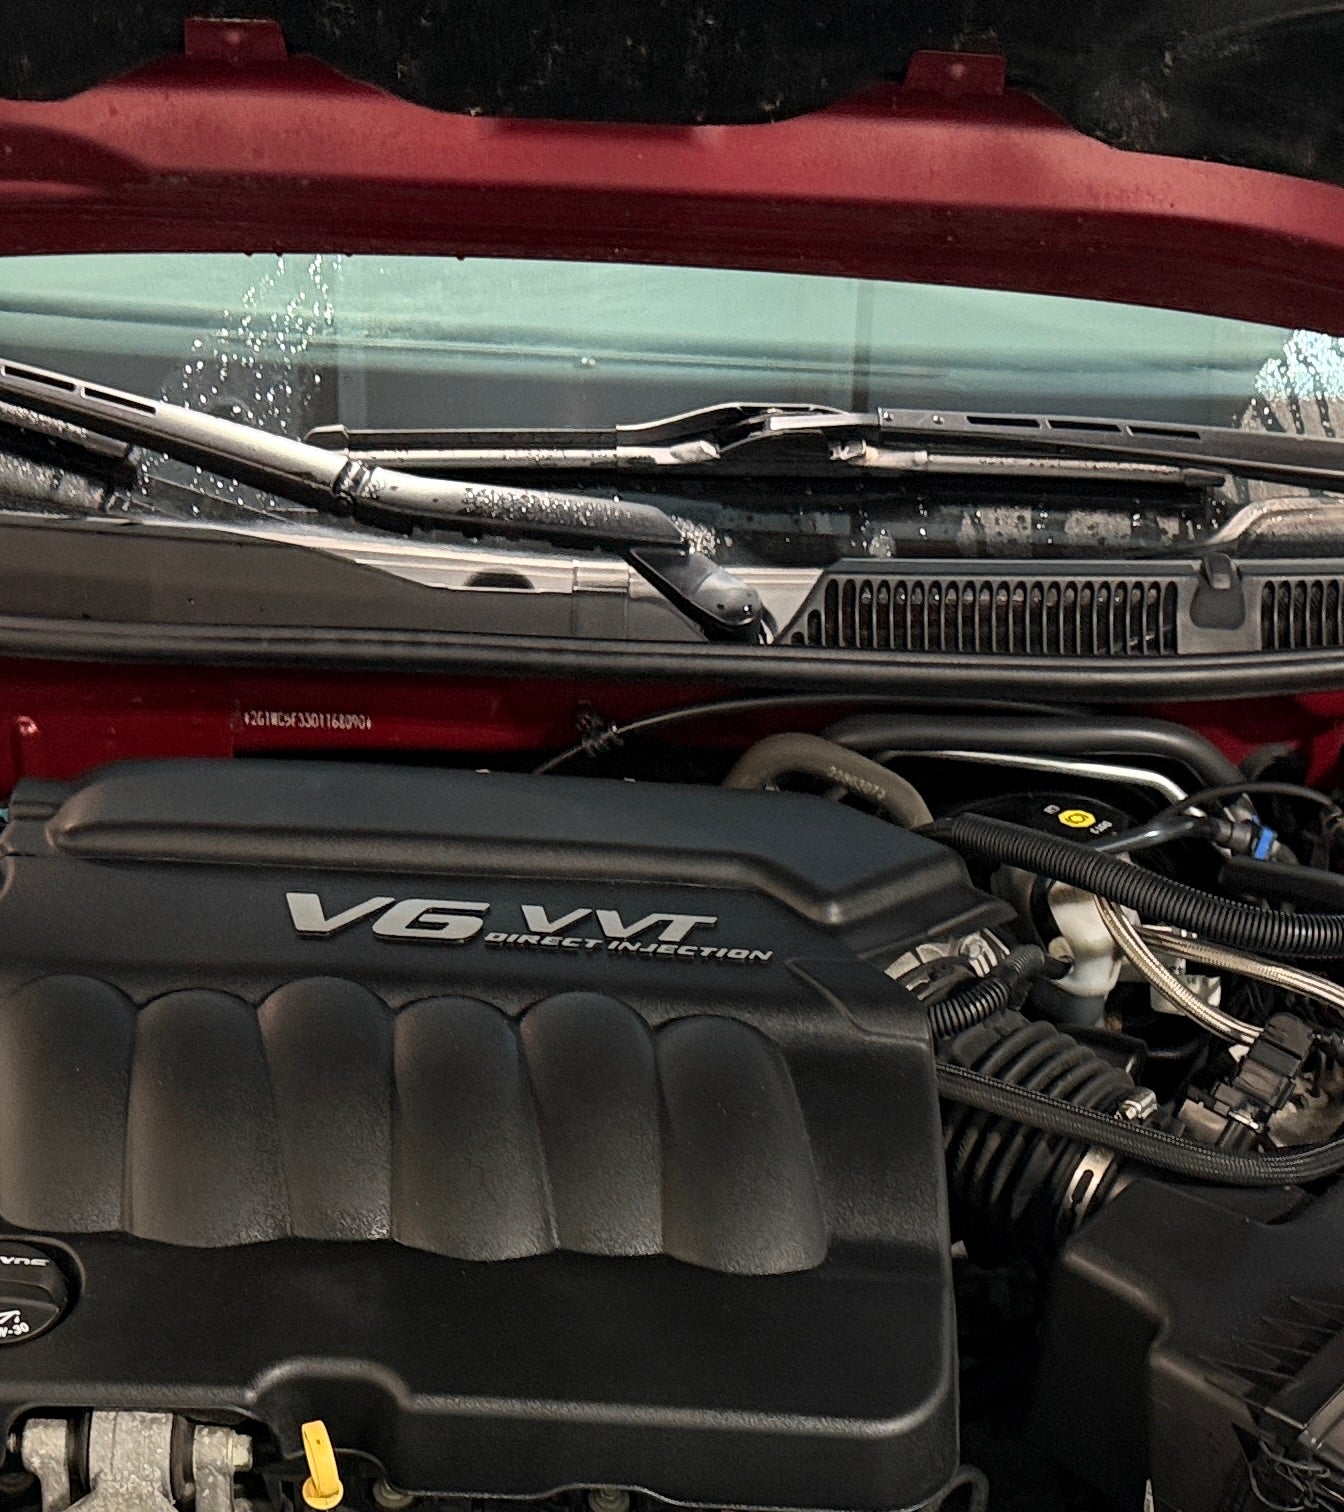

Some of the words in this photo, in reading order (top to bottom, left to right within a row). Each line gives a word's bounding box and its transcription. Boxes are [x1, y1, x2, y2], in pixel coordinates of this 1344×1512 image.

[286, 892, 490, 945] V6
[521, 904, 718, 945] VVT
[484, 931, 603, 952] DIRECT
[607, 939, 773, 963] INJECTION
